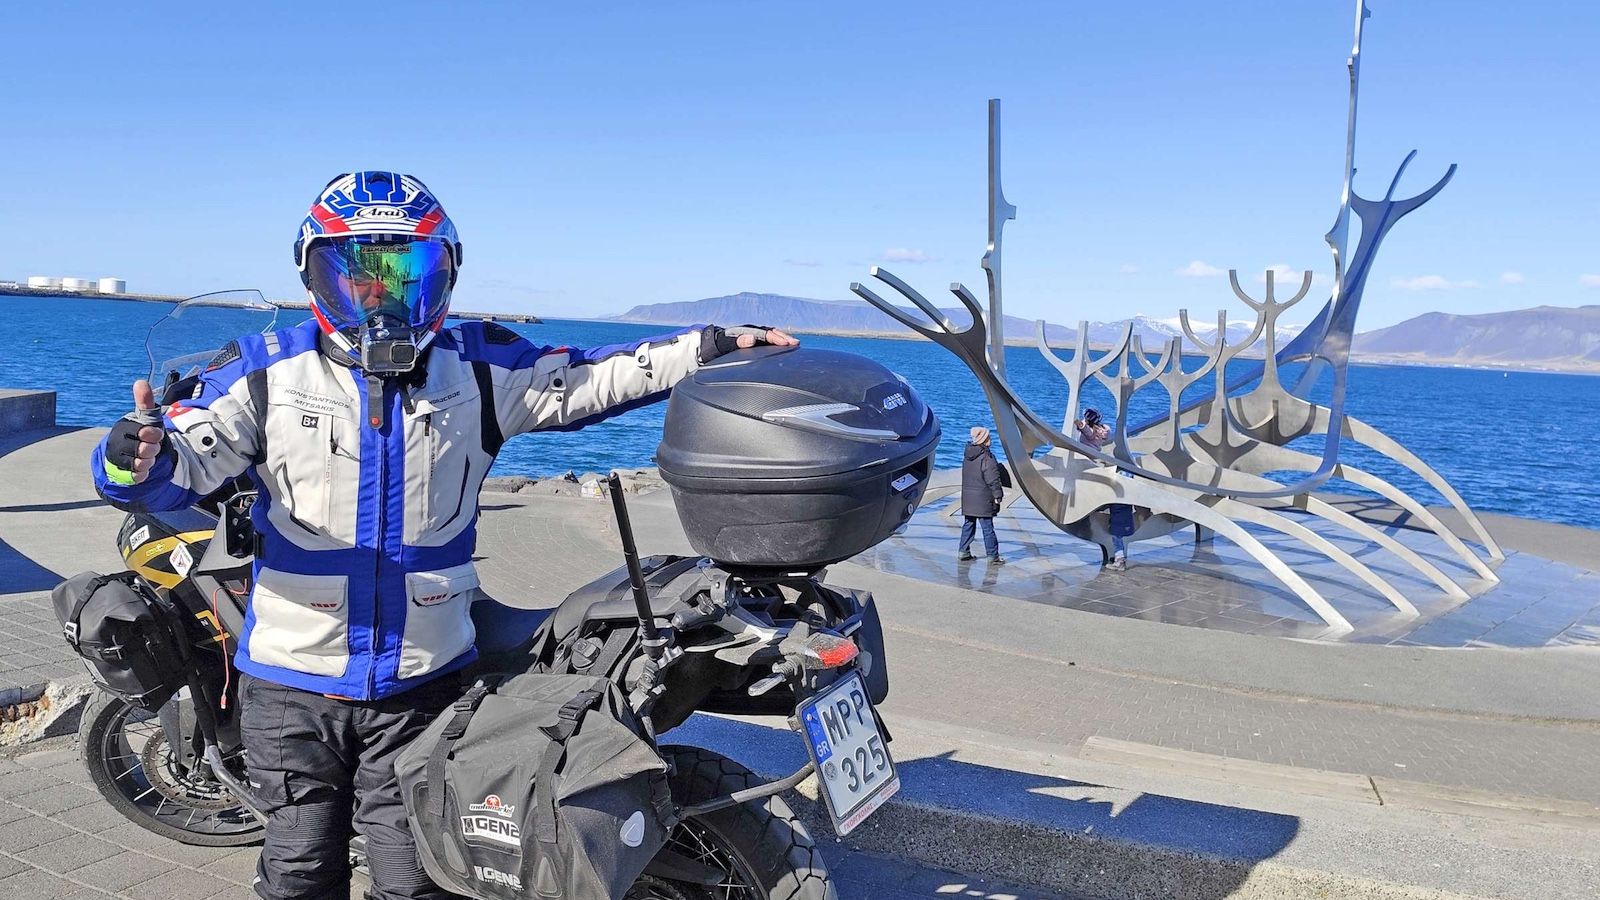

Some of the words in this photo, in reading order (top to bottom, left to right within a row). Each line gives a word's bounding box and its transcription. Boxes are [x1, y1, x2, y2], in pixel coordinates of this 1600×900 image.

[361, 207, 401, 217] Arai
[285, 389, 350, 409] KONSTANTINOS
[294, 399, 335, 411] MITSAKIS
[822, 690, 865, 746] MPP
[817, 741, 830, 757] GR
[841, 735, 886, 793] 325
